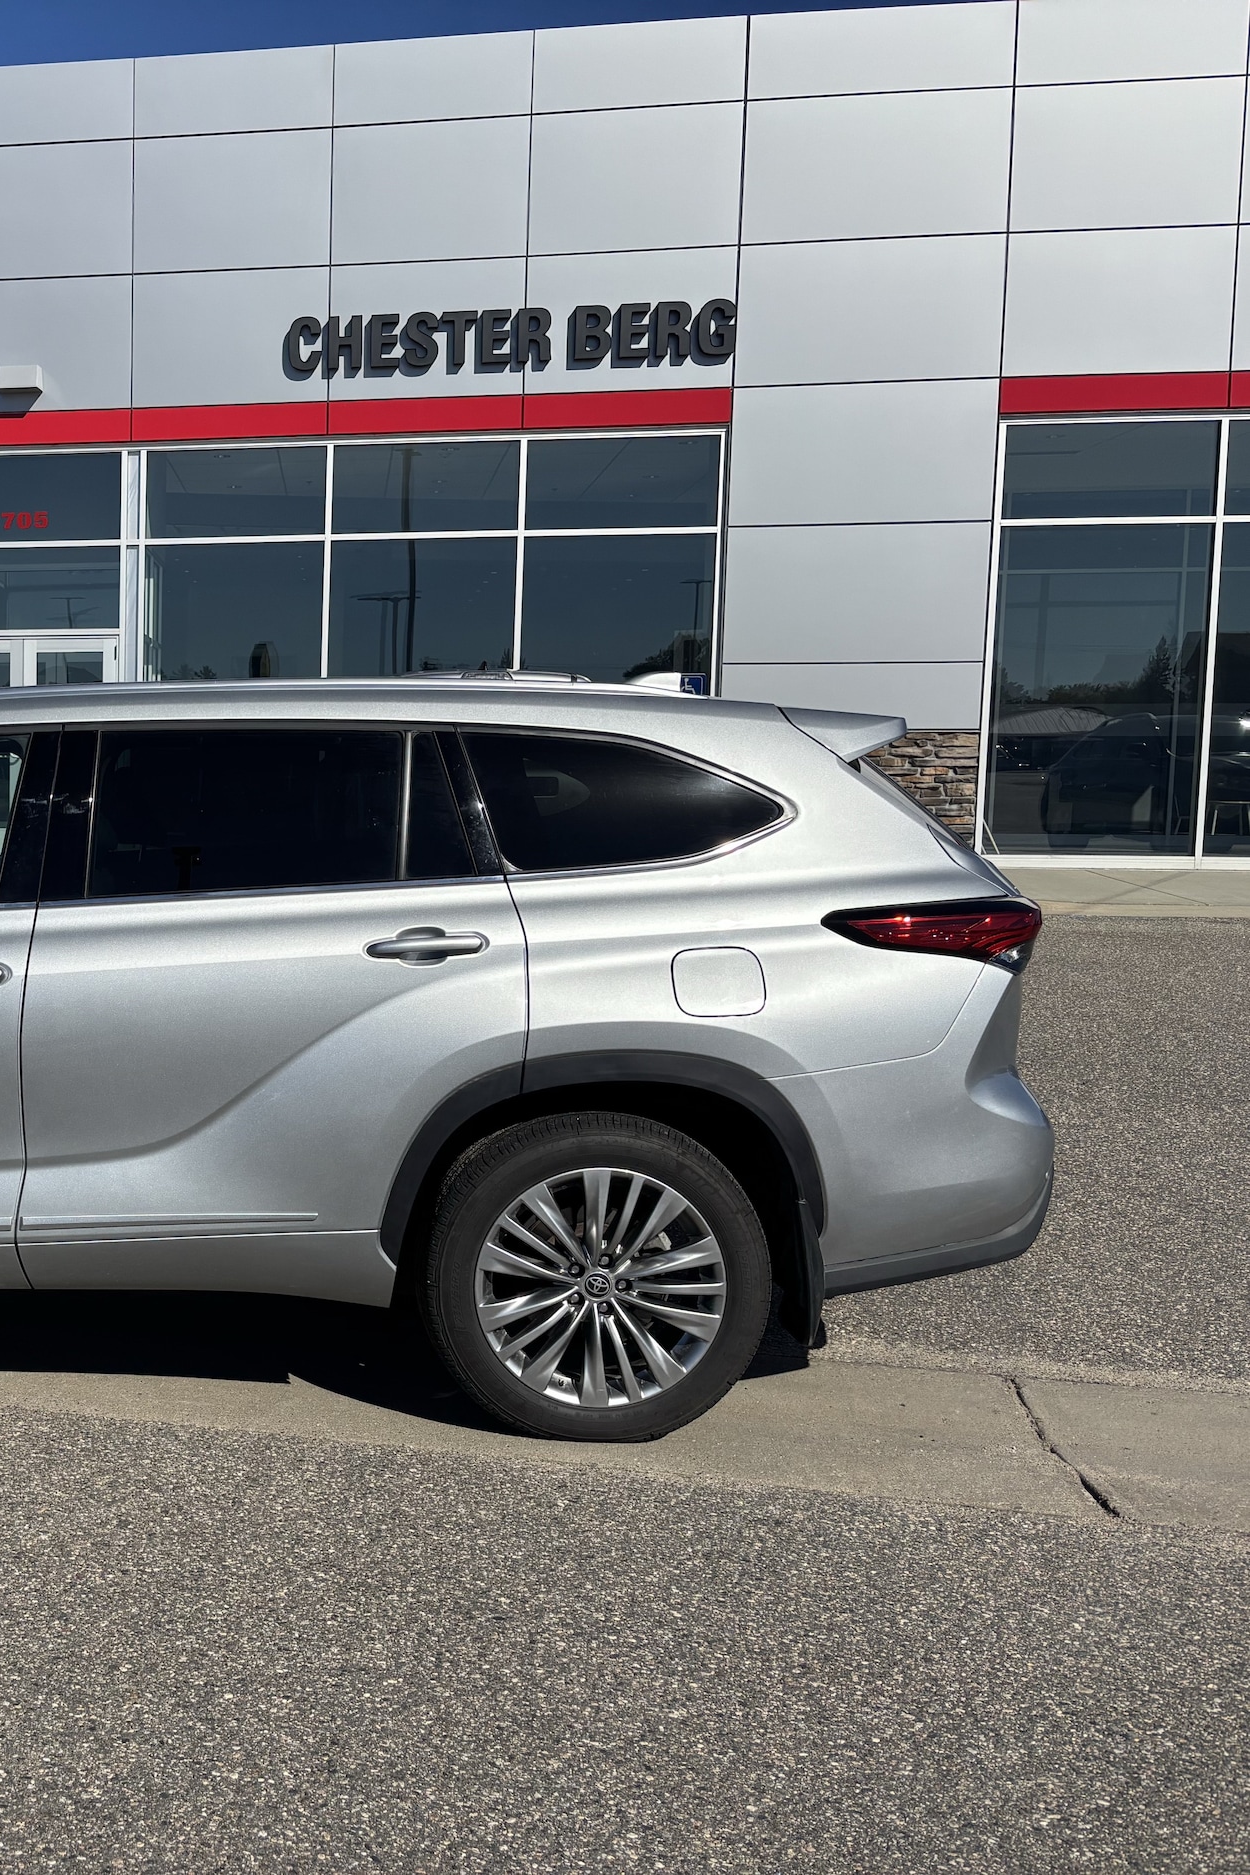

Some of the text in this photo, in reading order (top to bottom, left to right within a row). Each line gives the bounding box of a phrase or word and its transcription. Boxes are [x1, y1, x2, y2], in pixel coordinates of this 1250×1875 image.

[283, 298, 738, 379] CHESTER BERG
[1, 511, 49, 530] 705
